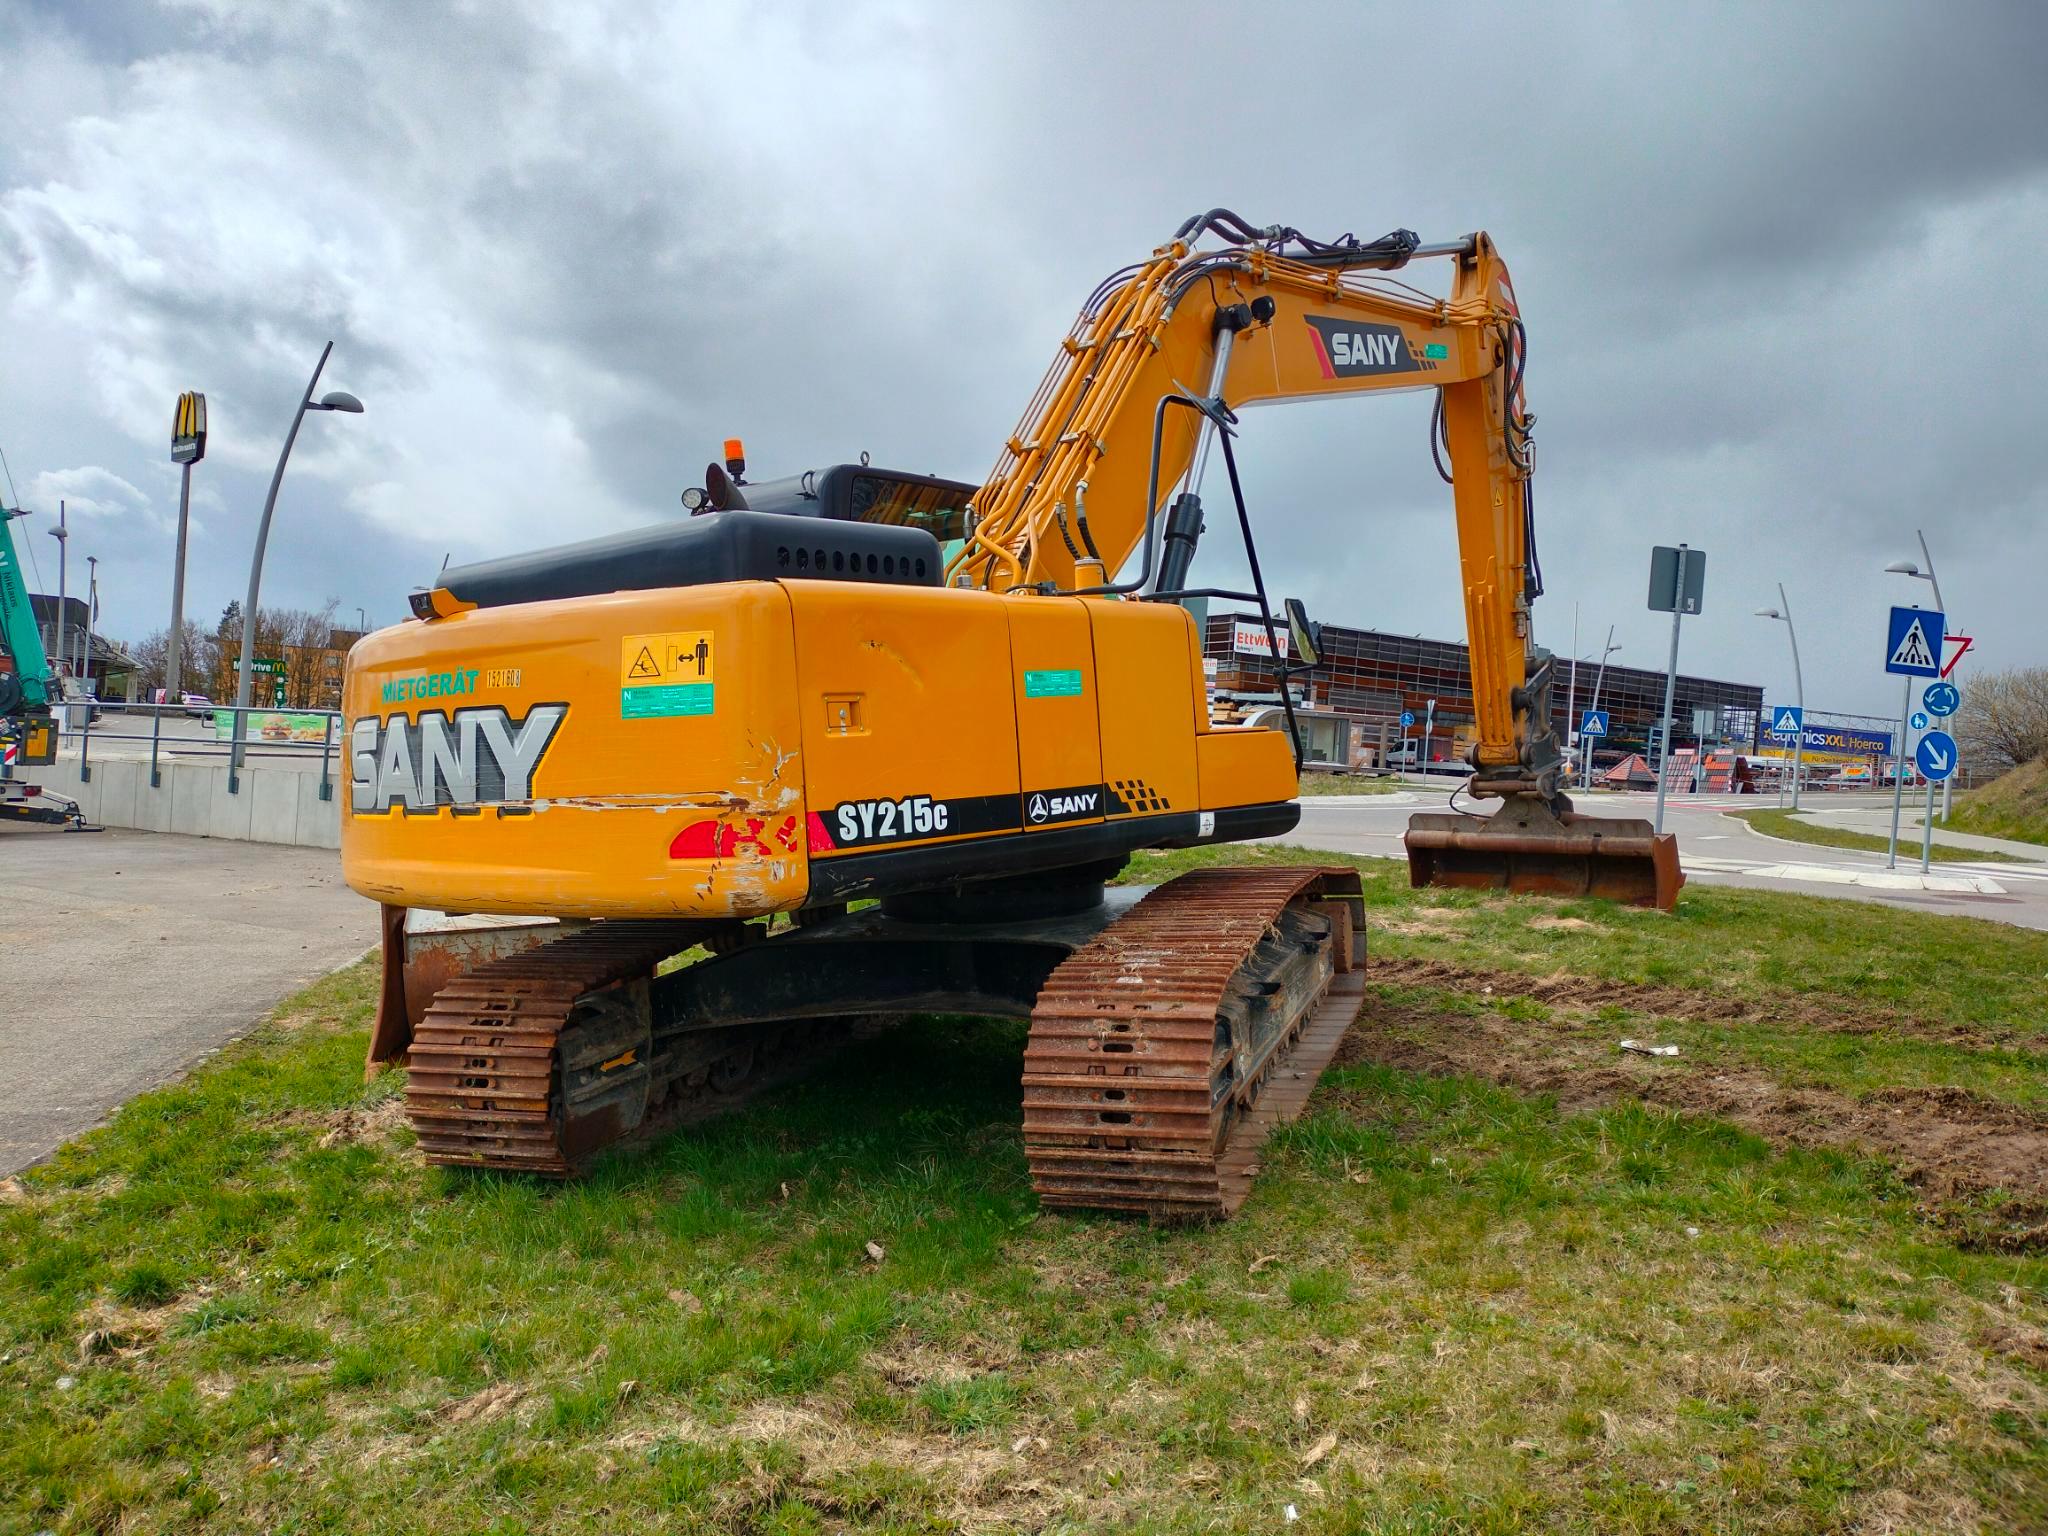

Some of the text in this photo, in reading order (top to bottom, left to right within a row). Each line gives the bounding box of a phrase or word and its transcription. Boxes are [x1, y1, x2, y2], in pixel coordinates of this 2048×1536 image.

[1332, 332, 1400, 366] SANY
[1237, 632, 1286, 649] Ettwn
[233, 660, 272, 672] Mrive
[382, 665, 481, 704] MIETGERÄT
[1849, 737, 1884, 751] Hoerco
[352, 703, 569, 811] SANY
[1050, 793, 1098, 815] SANY
